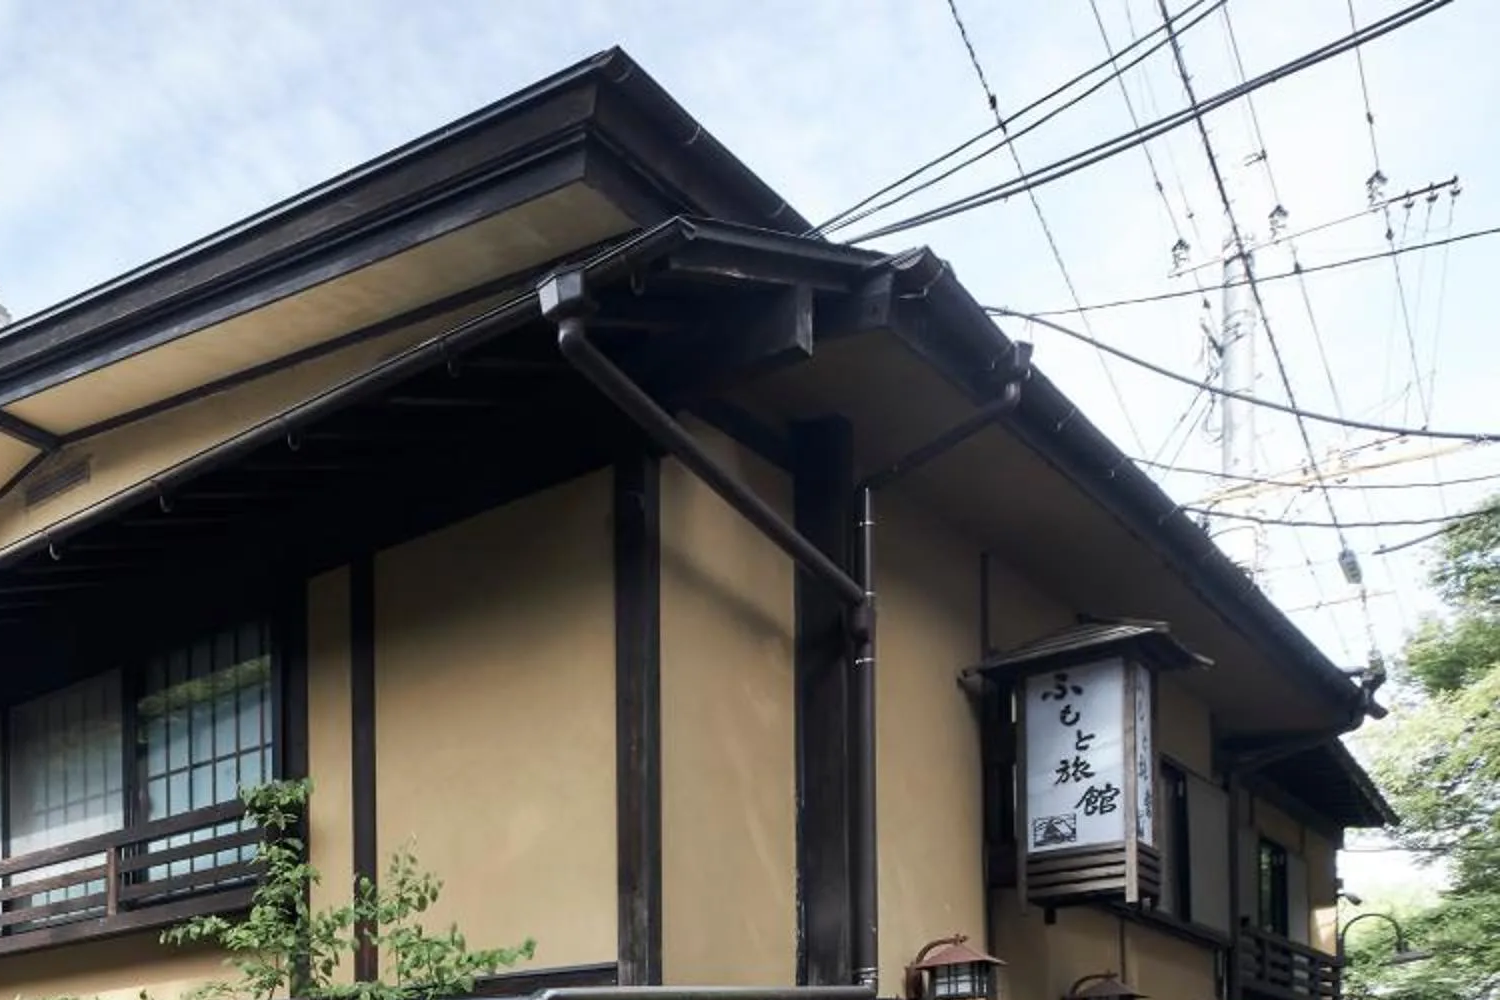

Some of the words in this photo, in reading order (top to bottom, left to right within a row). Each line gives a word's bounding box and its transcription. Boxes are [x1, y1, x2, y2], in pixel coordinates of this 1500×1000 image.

[1041, 672, 1121, 817] ふもと旅館
